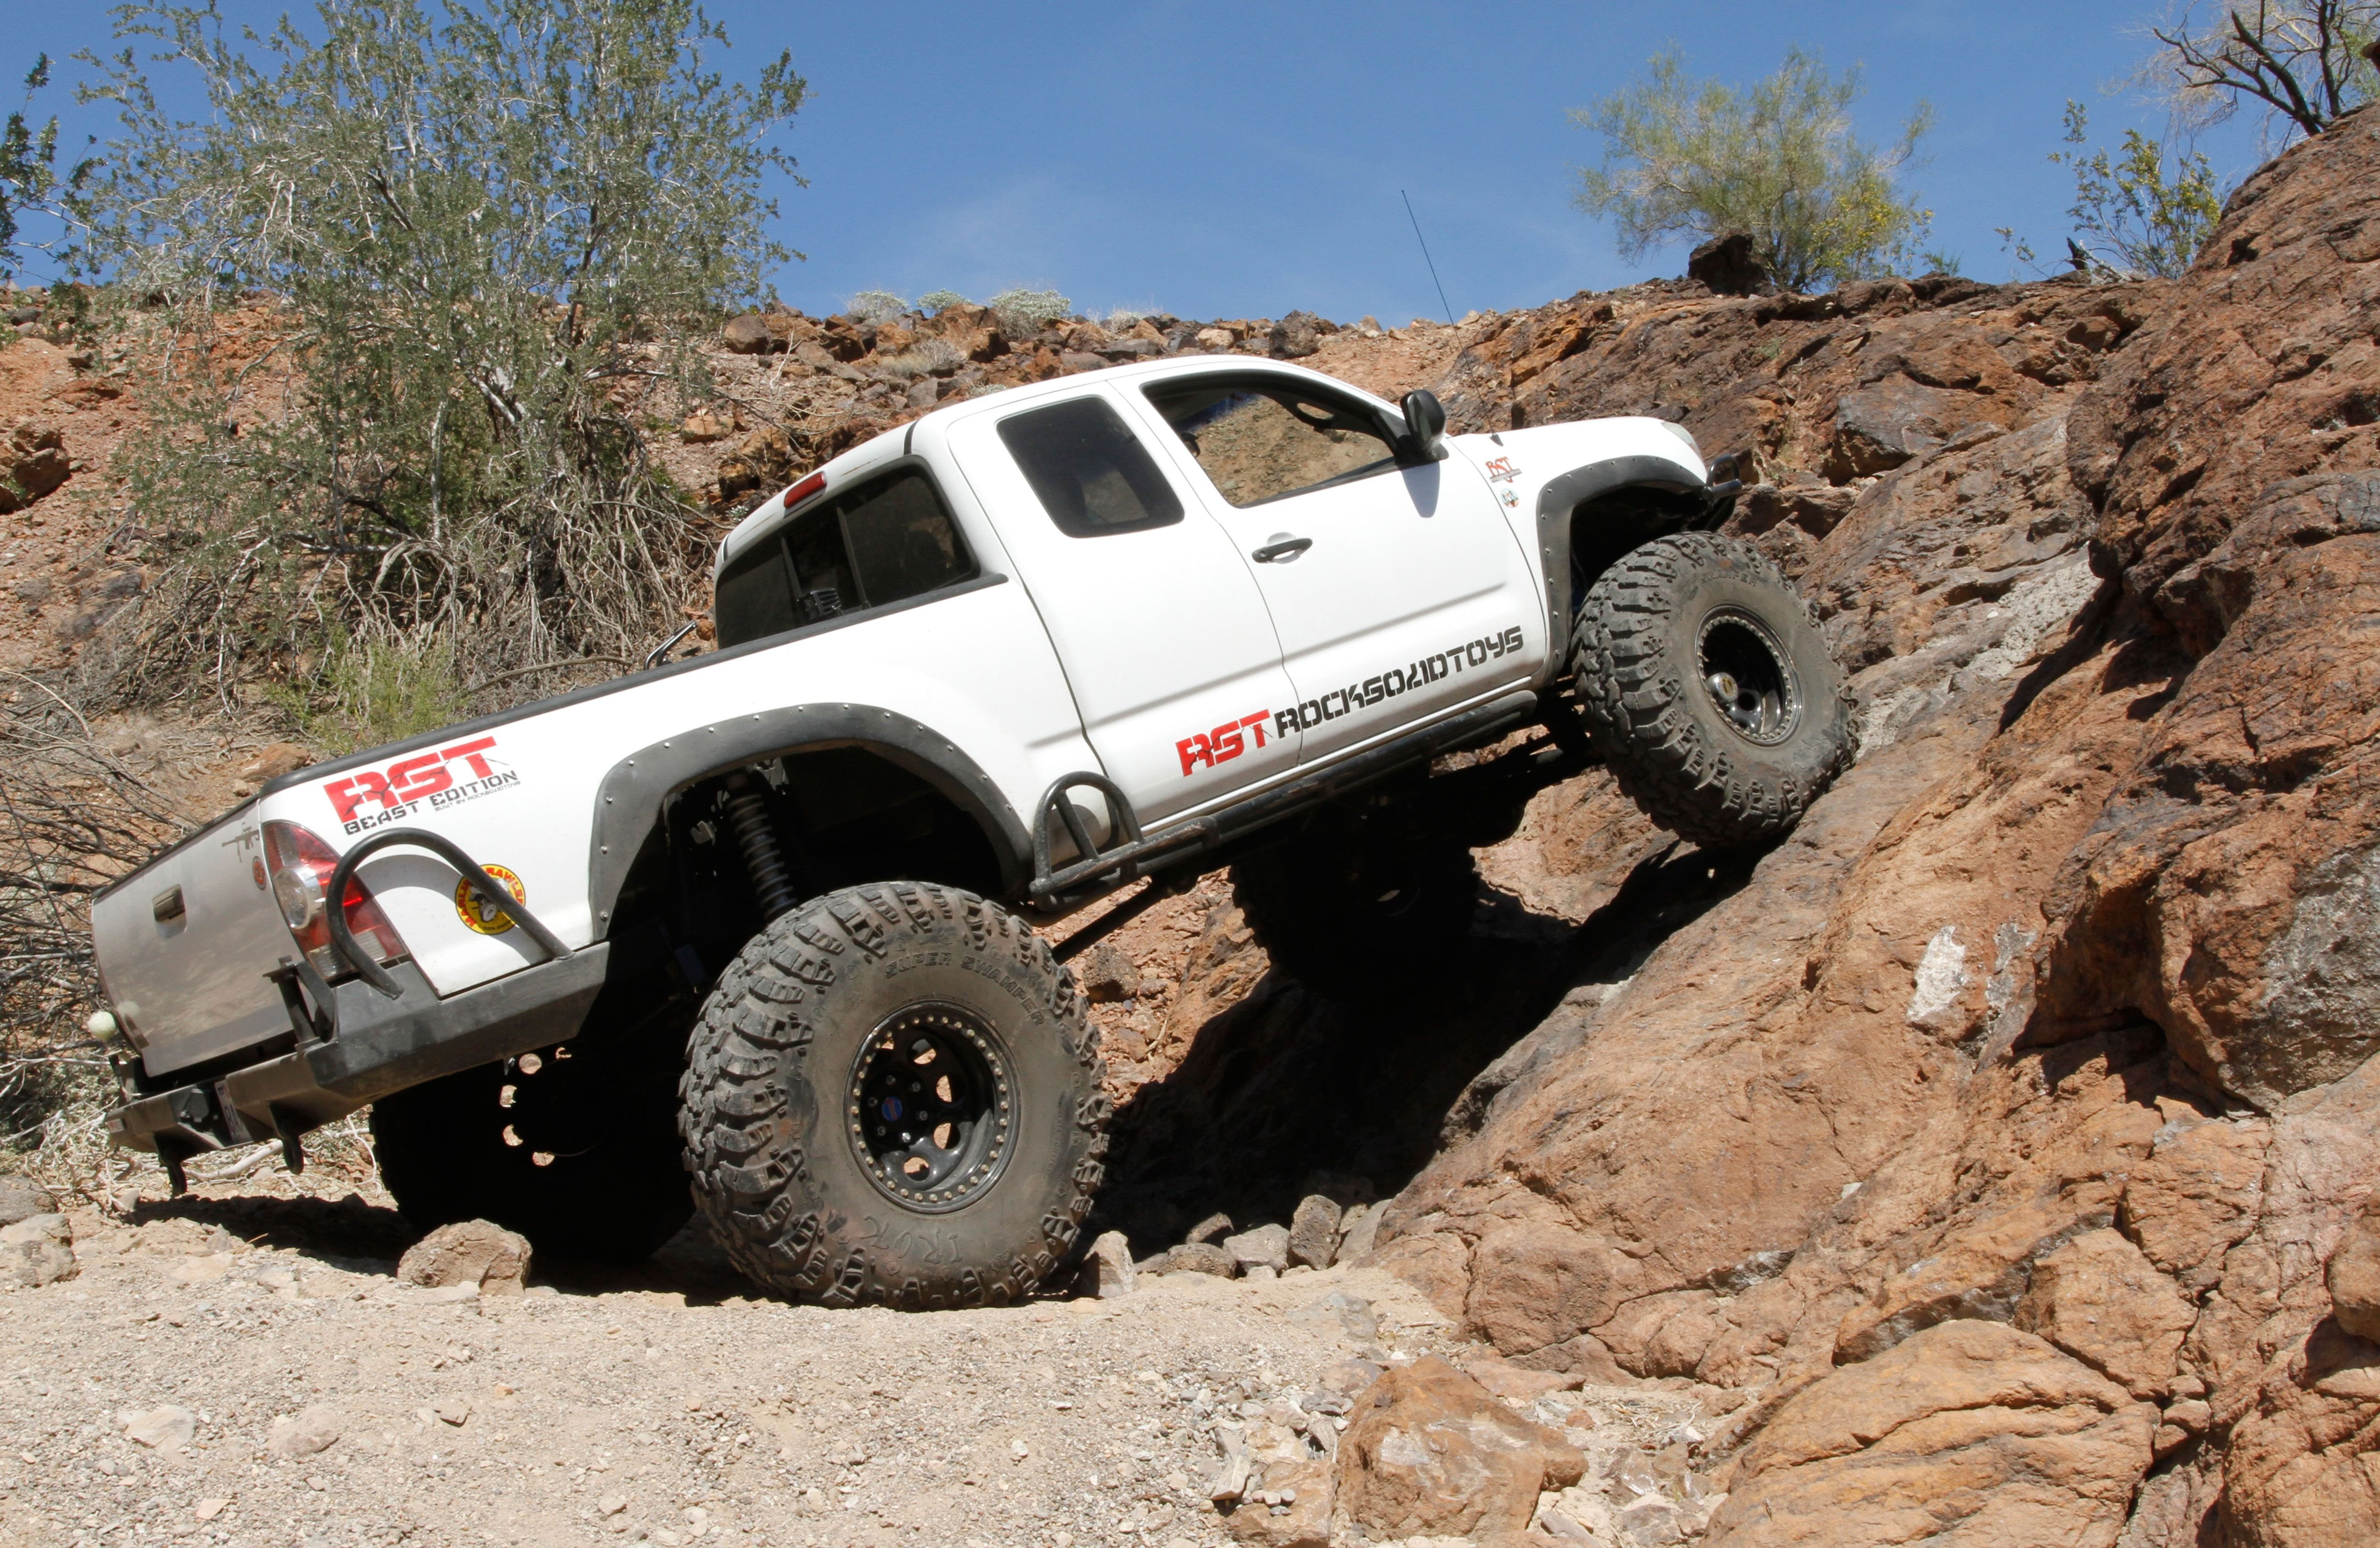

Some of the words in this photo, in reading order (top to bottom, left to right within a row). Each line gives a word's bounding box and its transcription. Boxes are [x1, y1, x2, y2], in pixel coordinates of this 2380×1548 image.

[1176, 709, 1270, 777] RST
[1274, 625, 1524, 739] ROCKSOLIDTOYS
[323, 736, 497, 823] RST
[344, 801, 418, 835] BEAST
[429, 770, 518, 807] EDITION
[435, 802, 454, 811] BUILT
[486, 868, 524, 904] RAWLE
[886, 952, 952, 979] SUPER
[961, 956, 1044, 1026] SWAMPER
